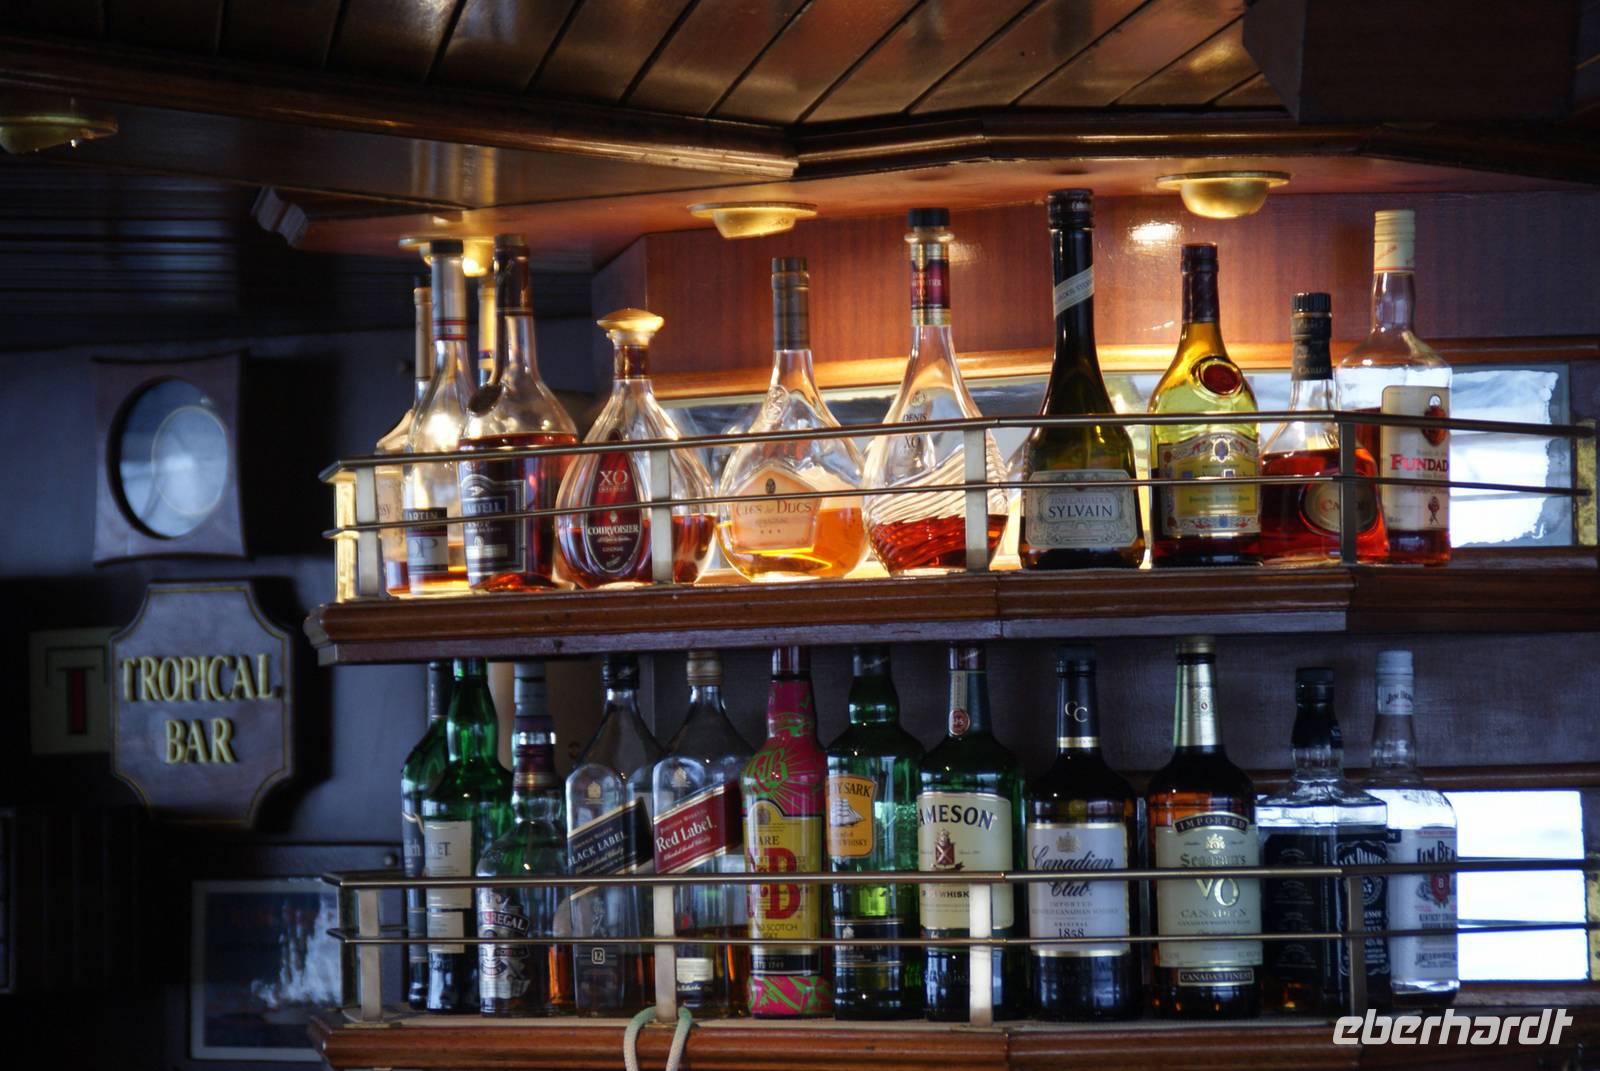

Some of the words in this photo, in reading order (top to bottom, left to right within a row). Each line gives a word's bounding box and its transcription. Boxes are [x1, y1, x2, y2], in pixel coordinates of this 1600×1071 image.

[904, 435, 921, 449] XO
[600, 471, 628, 486] XO
[408, 511, 439, 521] ARTIN
[1049, 505, 1113, 518] SYLVAIN
[587, 524, 640, 536] COURVOISIER
[121, 654, 276, 702] TROPICAL
[1064, 701, 1088, 723] CC
[164, 718, 236, 764] BAR
[844, 782, 871, 797] SARK
[1179, 816, 1246, 831] IMPORTED
[656, 831, 680, 853] Red
[680, 815, 713, 841] Label
[750, 835, 780, 846] ARE
[568, 844, 596, 866] BLACK
[598, 830, 626, 850] LABEL
[1031, 846, 1114, 869] Canadian
[490, 914, 526, 931] REGAL
